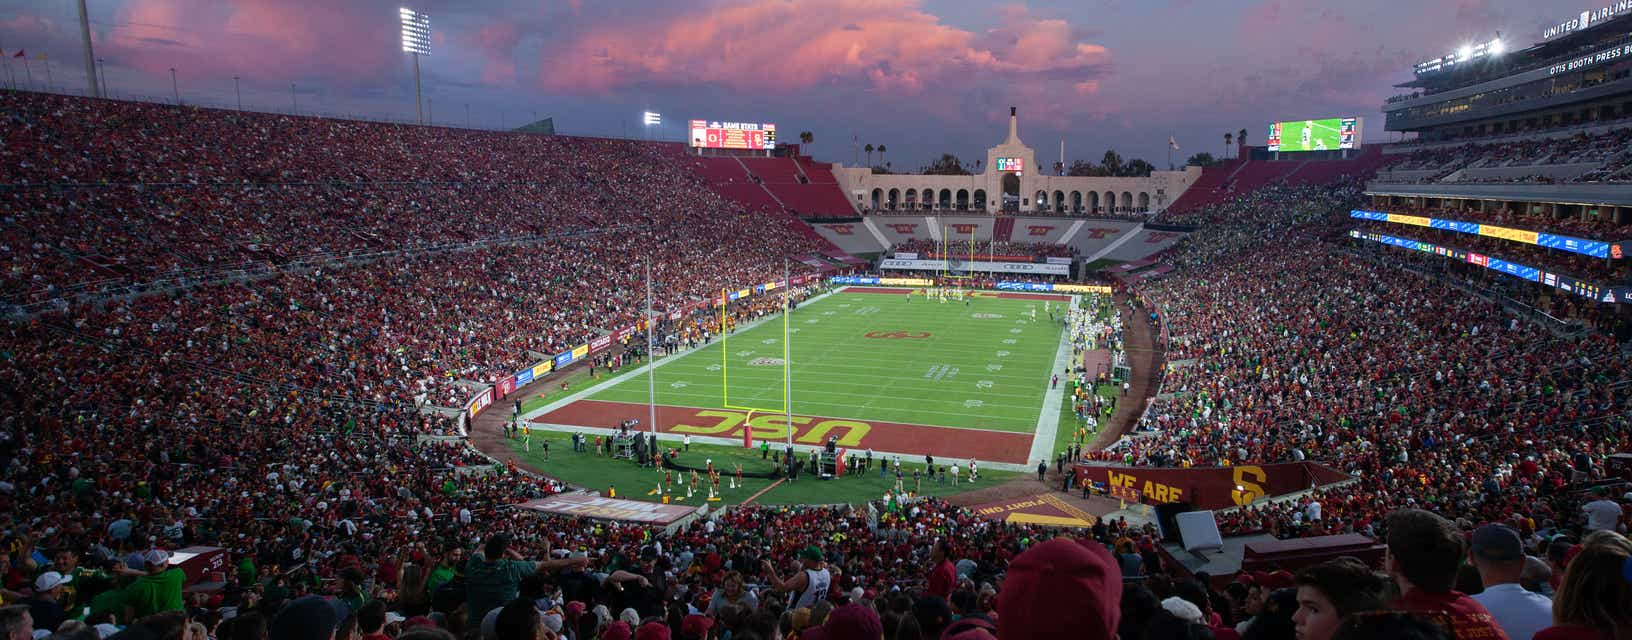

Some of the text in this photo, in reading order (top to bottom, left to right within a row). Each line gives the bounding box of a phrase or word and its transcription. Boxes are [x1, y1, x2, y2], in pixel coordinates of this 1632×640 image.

[1543, 19, 1578, 38] UNITED
[1550, 63, 1566, 75] OTIS
[1568, 56, 1593, 70] BOOTH
[1596, 48, 1621, 63] PRESS
[670, 410, 872, 447] USC
[1107, 470, 1137, 488] WE
[1142, 480, 1183, 504] ARE
